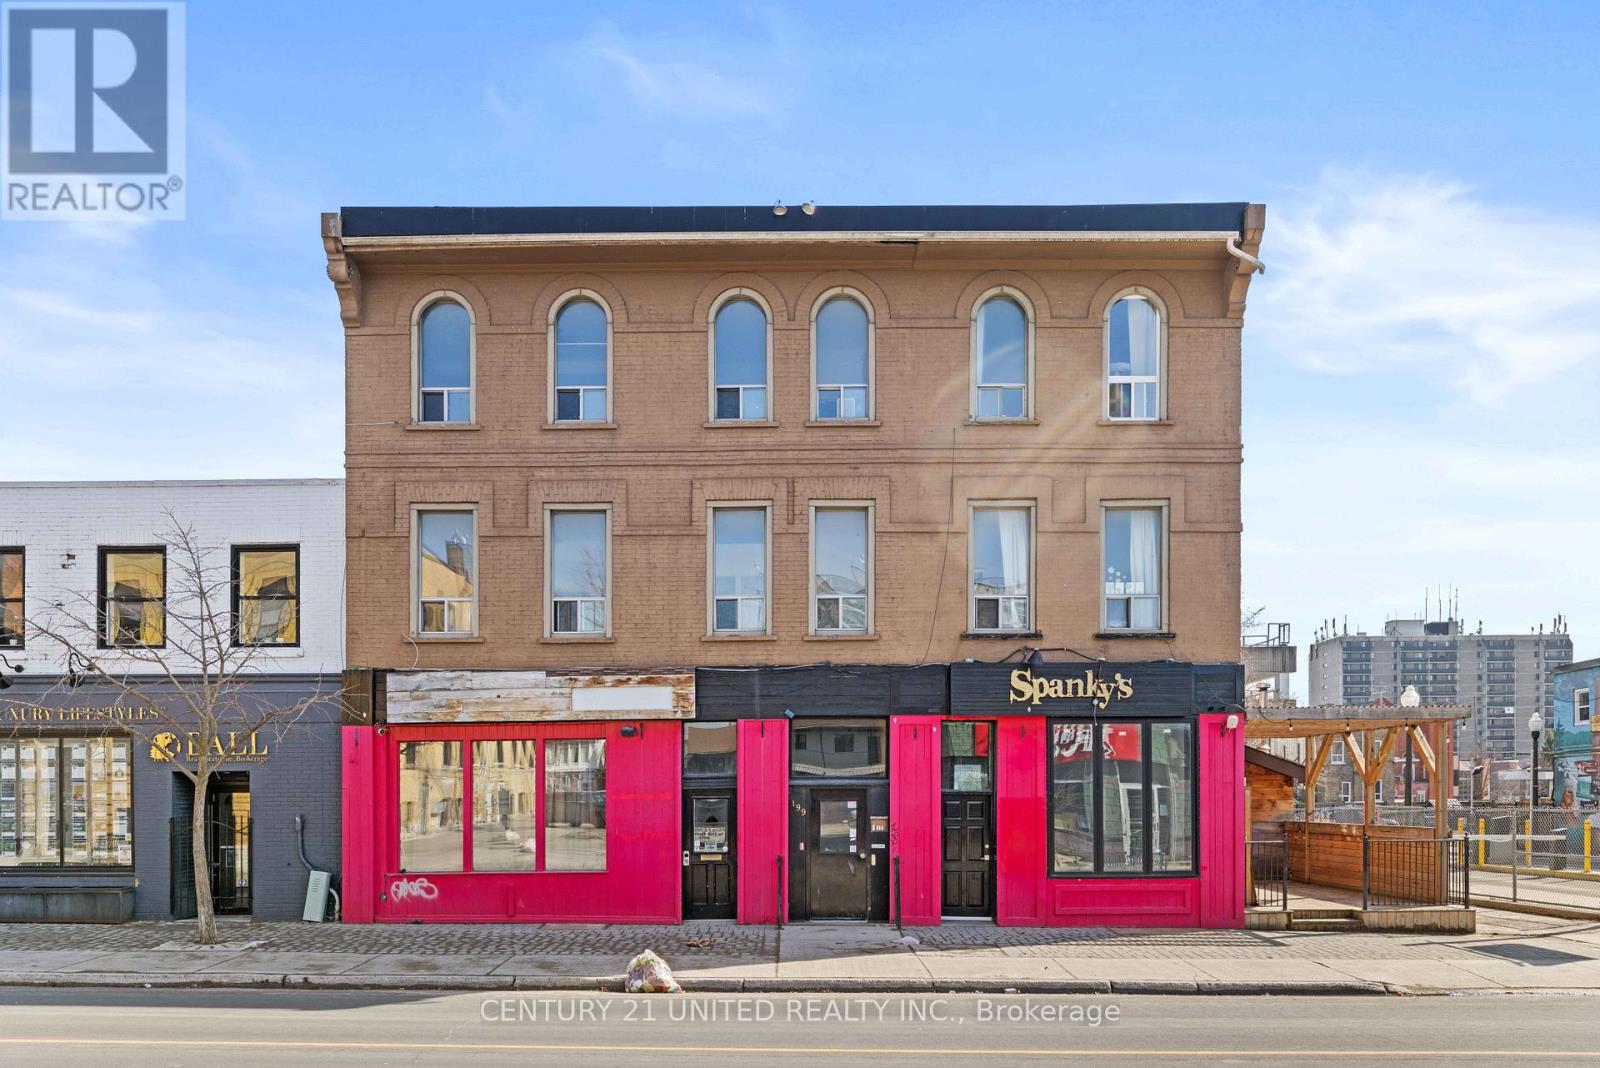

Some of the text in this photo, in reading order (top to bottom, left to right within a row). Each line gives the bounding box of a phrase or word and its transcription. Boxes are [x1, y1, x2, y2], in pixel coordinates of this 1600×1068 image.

[1009, 667, 1134, 709] Spanky's
[0, 707, 53, 721] XURY
[792, 799, 807, 817] 199
